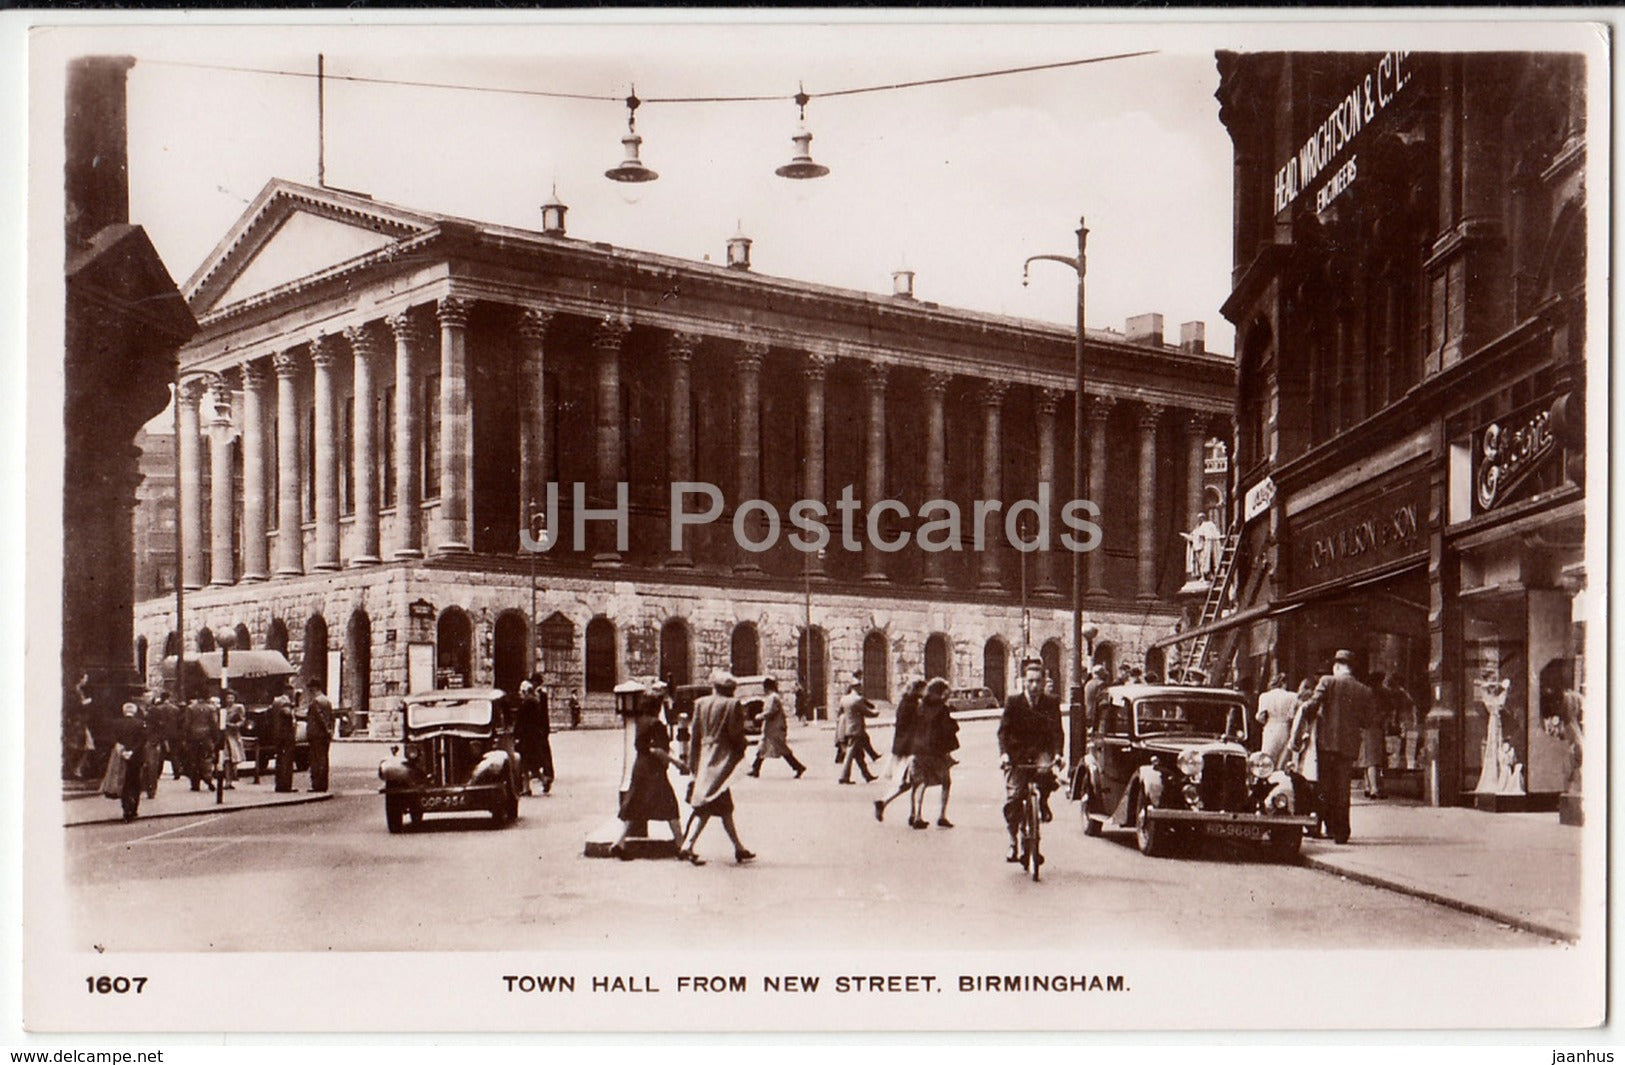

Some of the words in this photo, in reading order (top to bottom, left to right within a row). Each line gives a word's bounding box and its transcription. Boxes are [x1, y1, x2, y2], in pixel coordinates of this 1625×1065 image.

[1299, 85, 1361, 190] WRIGHTSON
[1364, 74, 1375, 123] &
[1316, 154, 1357, 215] ENGINEERS
